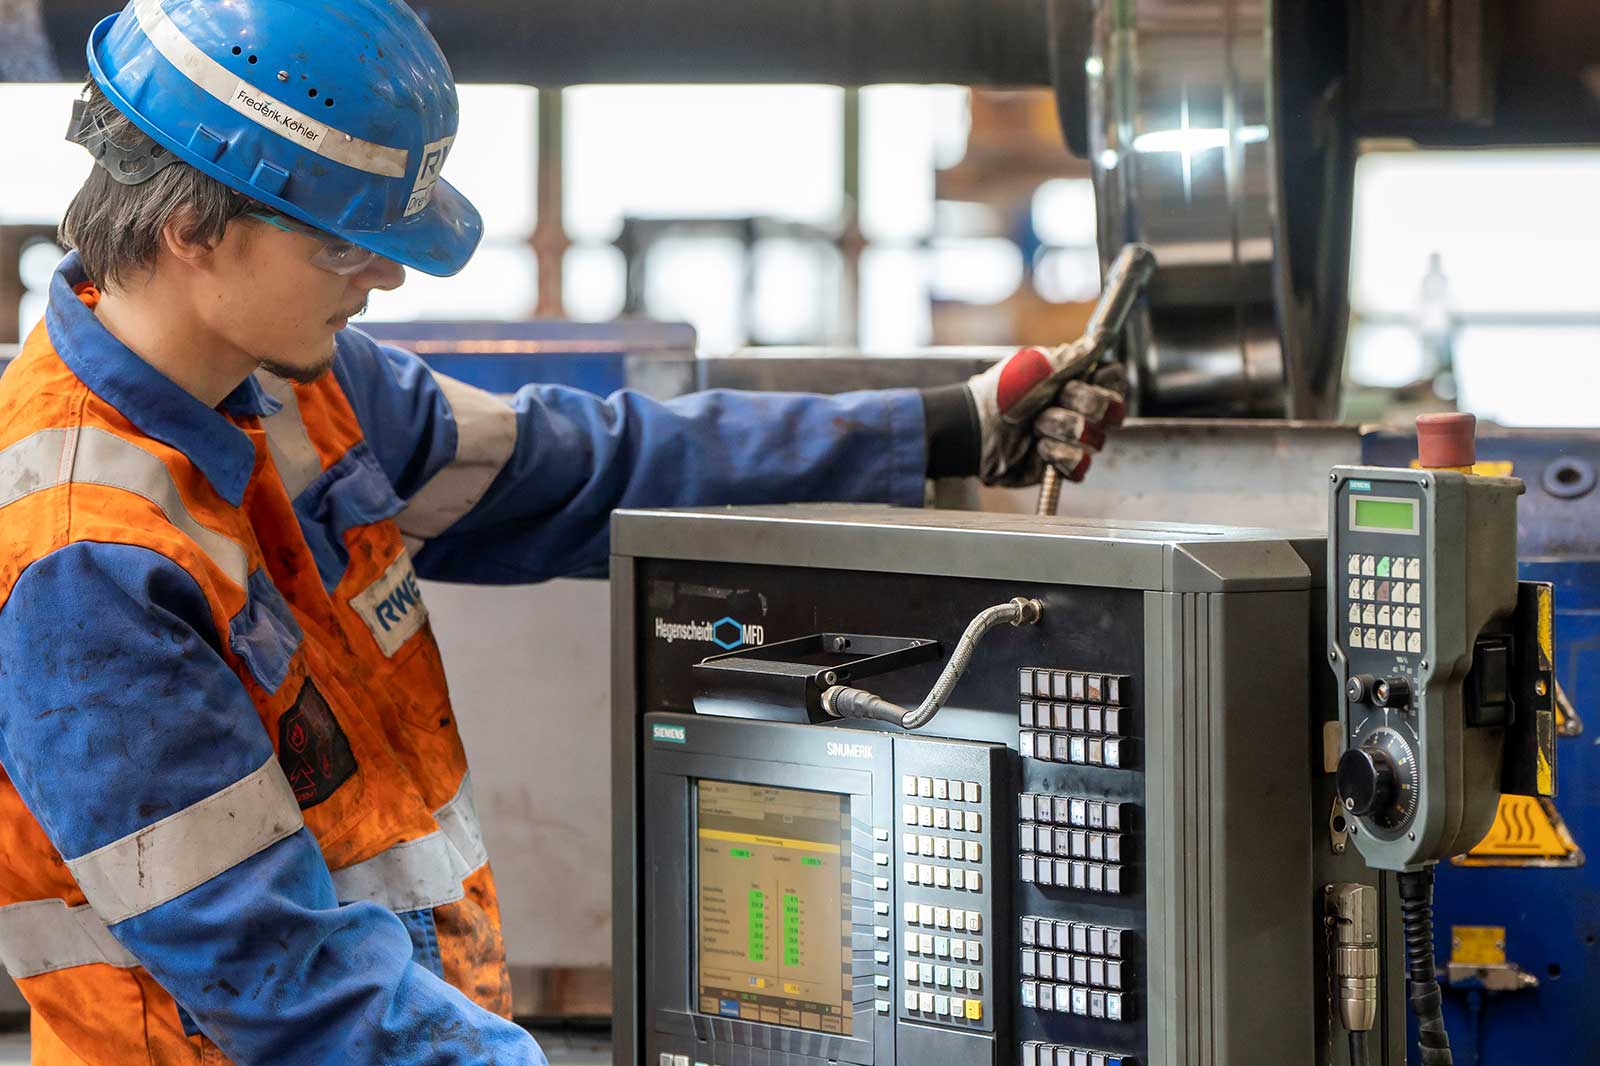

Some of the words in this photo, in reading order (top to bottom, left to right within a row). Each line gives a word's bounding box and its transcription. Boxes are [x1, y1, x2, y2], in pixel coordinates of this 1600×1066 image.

[282, 116, 319, 141] Köhler
[655, 617, 713, 643] Hegenscheidt
[742, 624, 764, 645] MFD
[654, 727, 685, 740] SIEMENS
[826, 742, 873, 759] SINUMERIK
